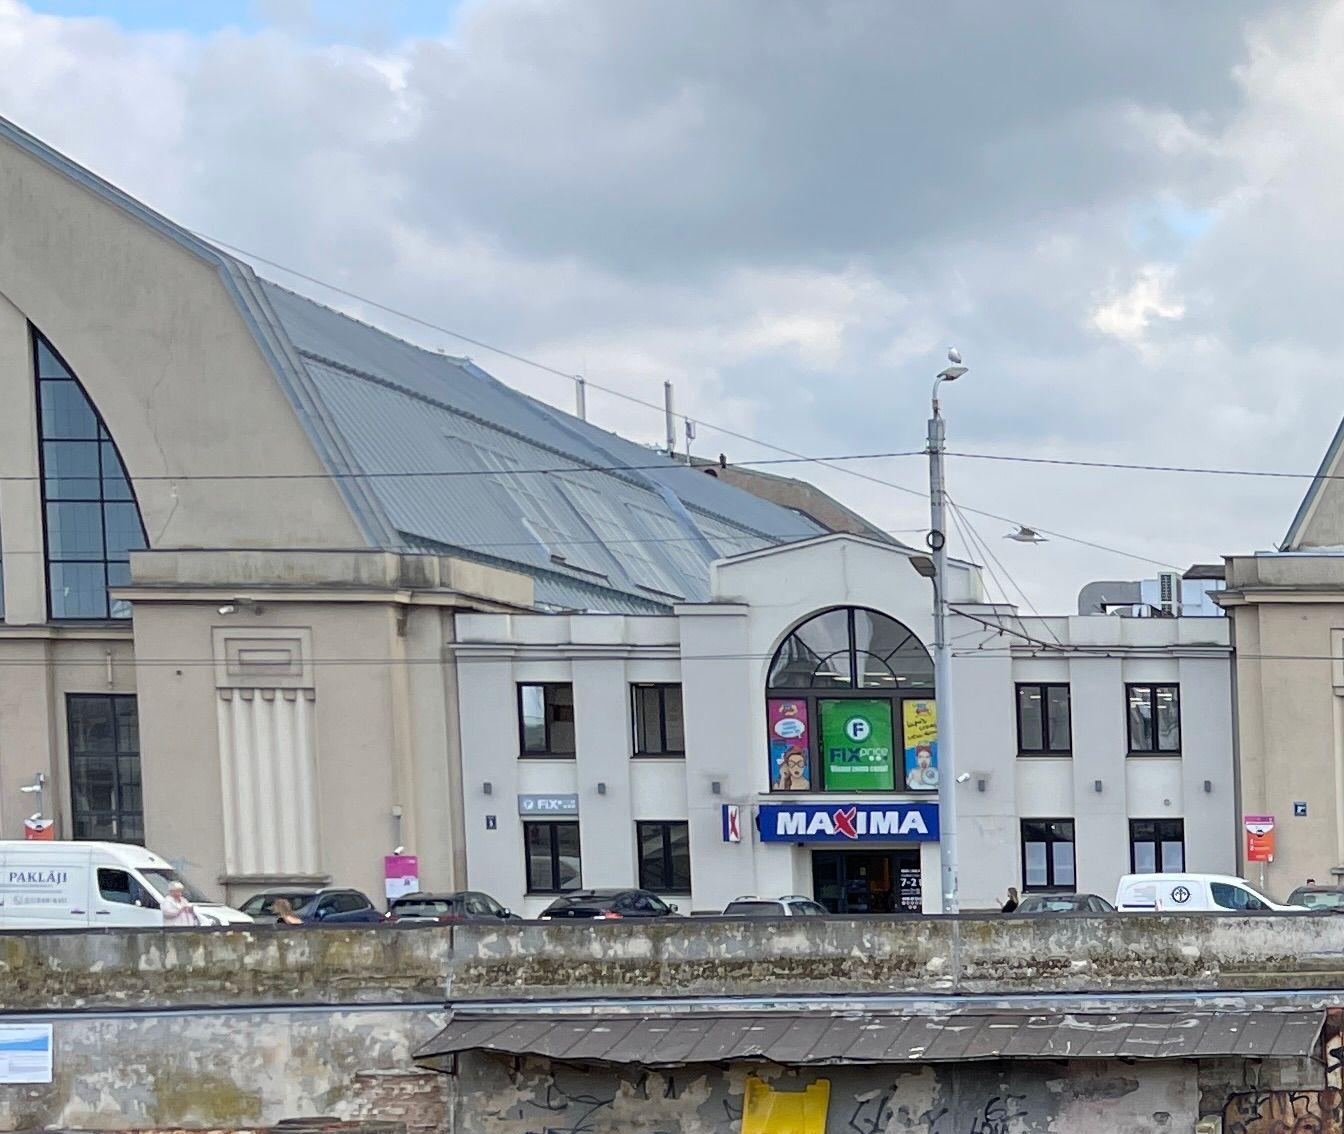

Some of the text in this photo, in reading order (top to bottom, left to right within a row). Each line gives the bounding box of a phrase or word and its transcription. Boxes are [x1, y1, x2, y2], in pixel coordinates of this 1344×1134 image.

[830, 748, 862, 762] FIX
[776, 806, 928, 839] MAXIMA
[9, 870, 67, 885] PAKLĀJI
